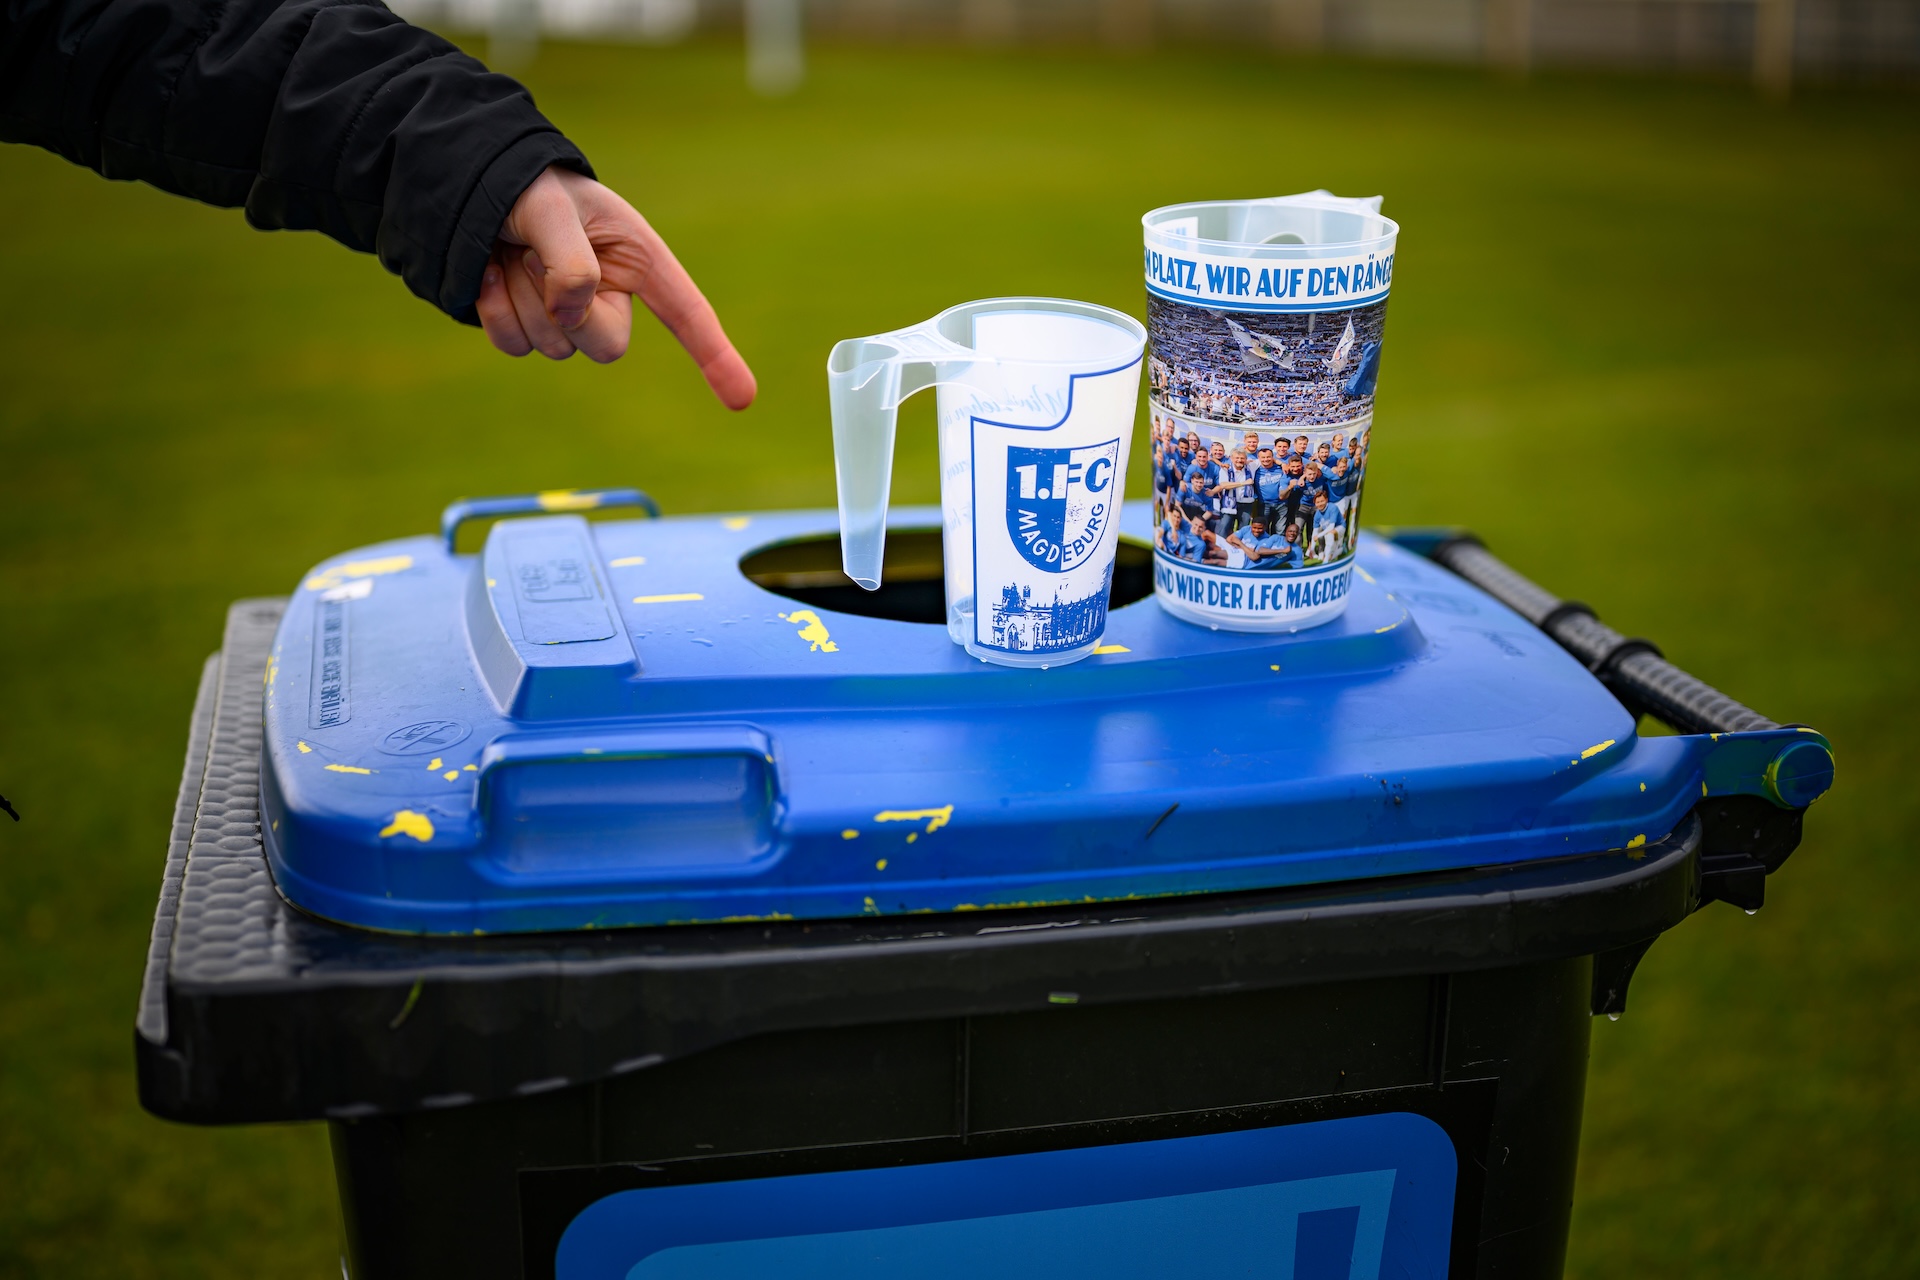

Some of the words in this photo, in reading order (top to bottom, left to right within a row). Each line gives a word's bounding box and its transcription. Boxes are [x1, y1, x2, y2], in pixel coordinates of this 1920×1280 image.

[1152, 251, 1202, 295] PLATZ,
[1205, 263, 1250, 297] WIR
[1255, 267, 1302, 298] AUF
[1307, 265, 1350, 297] DEN
[1352, 253, 1395, 293] RÄNGE
[1014, 458, 1111, 500] 1.FC
[1018, 503, 1104, 563] MAGDEBURG
[1176, 572, 1204, 604] WIR
[1208, 581, 1243, 610] DER
[1248, 583, 1284, 611] 1.FC
